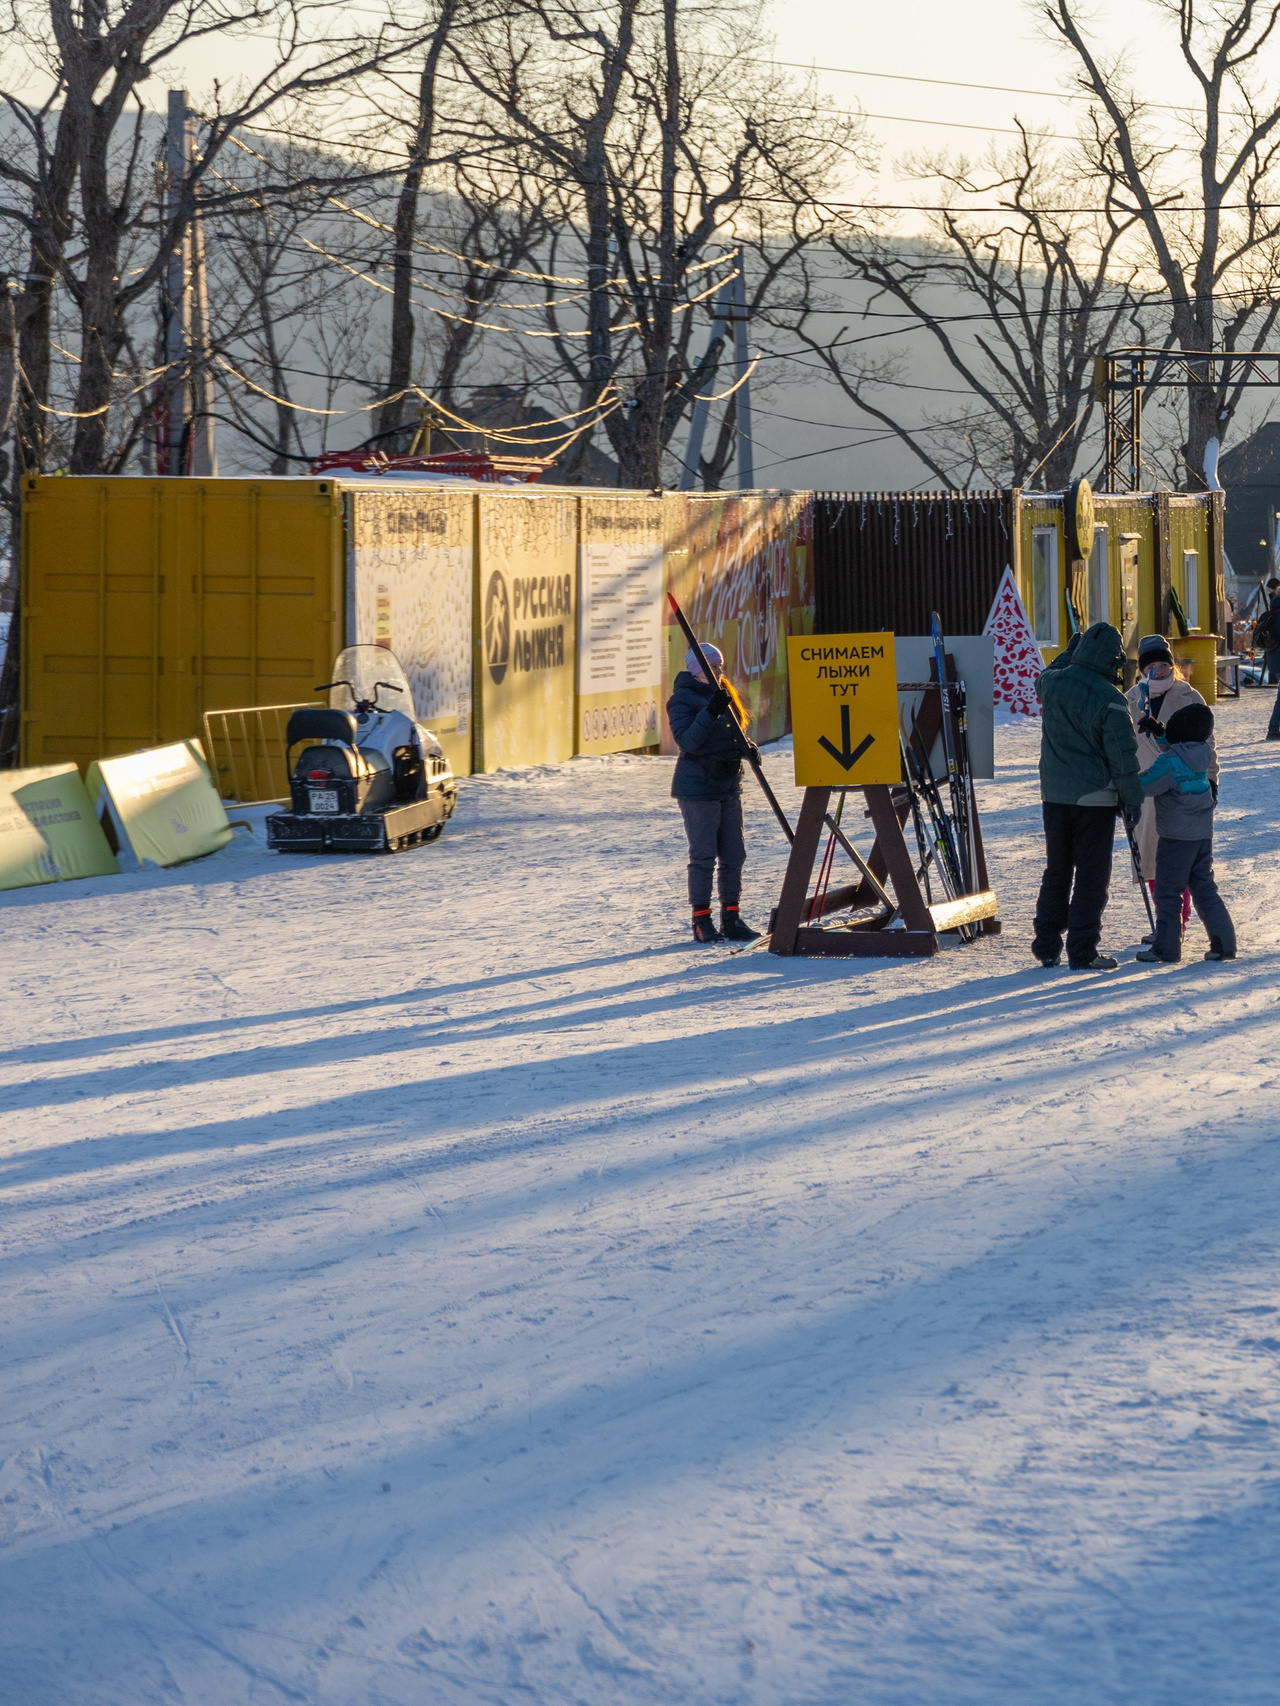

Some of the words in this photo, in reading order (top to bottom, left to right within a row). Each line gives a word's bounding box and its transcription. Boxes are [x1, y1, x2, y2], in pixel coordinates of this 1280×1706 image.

[513, 573, 571, 620] РУССКАЯ
[513, 624, 564, 673] ЛЫЖНЯ
[800, 646, 884, 661] СНИМАЕМ
[816, 665, 870, 679] ЛЫЖИ
[829, 684, 859, 696] ТУТ
[942, 688, 950, 714] TISA
[315, 802, 336, 811] 0024
